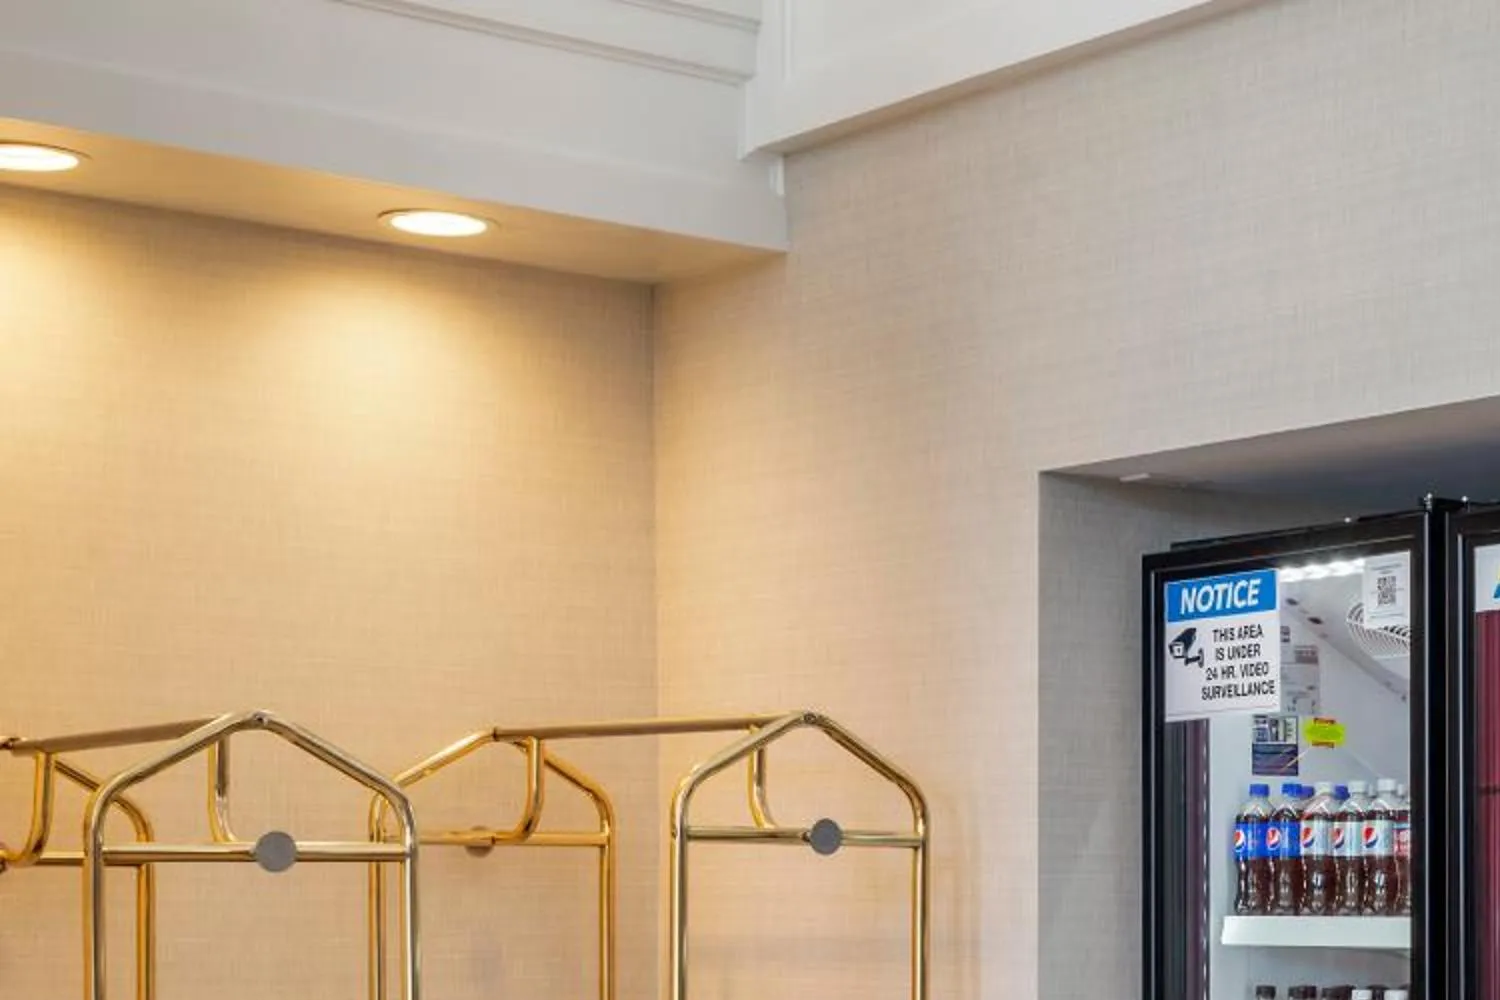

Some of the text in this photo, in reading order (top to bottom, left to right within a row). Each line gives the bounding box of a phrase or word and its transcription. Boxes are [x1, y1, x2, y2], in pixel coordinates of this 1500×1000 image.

[1180, 578, 1262, 615] NOTICE
[1212, 624, 1264, 642] THIS AREA
[1215, 644, 1261, 661] IS UNDER
[1205, 667, 1218, 681] 24
[1240, 662, 1270, 678] VIDEO
[1201, 680, 1275, 701] SURVEILLANCE
